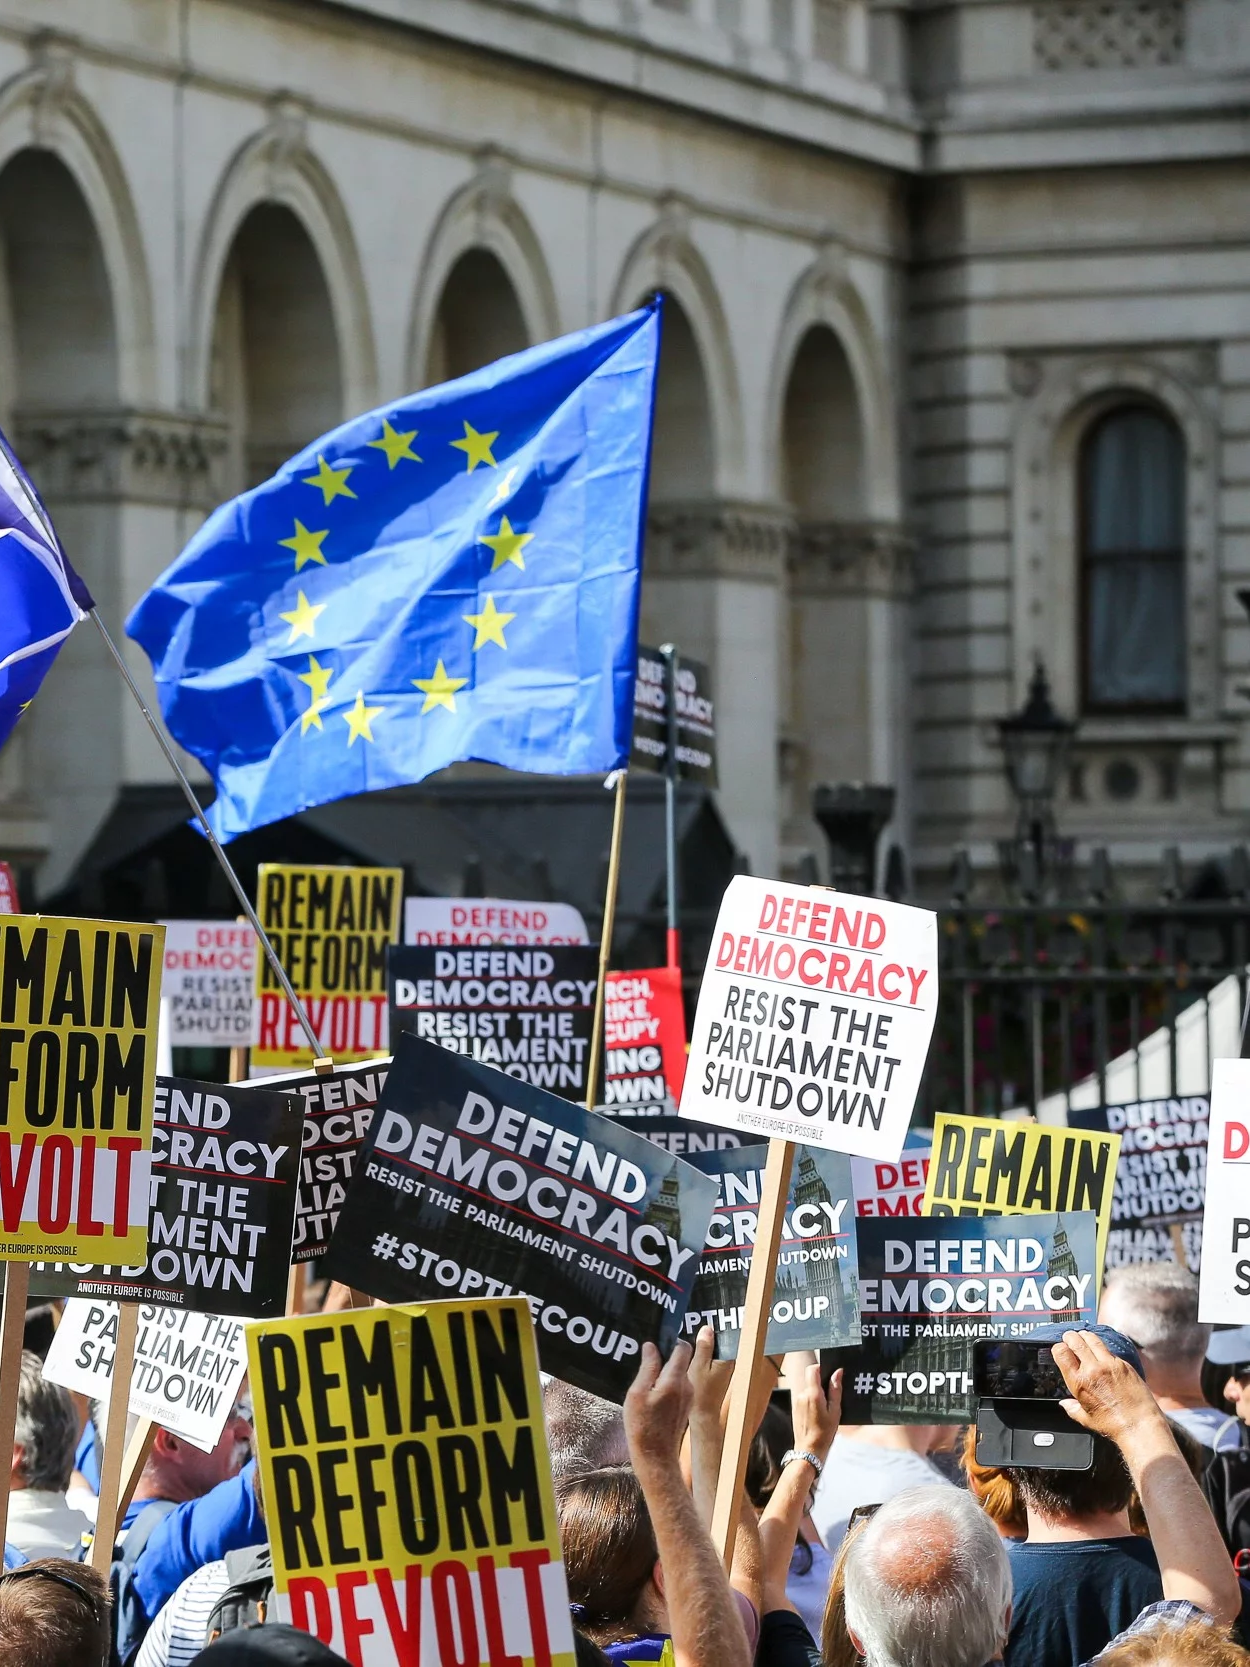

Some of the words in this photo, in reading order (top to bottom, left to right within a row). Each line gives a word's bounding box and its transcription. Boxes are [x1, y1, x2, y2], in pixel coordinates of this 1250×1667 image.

[264, 873, 396, 932] REMAIN
[451, 906, 548, 931] DEFEND
[757, 893, 887, 951] DEFEND
[165, 951, 253, 970] DEMOC
[260, 932, 391, 993] REFORM
[434, 950, 555, 978] DEFEND
[715, 931, 929, 1006] DEMOCRACY
[395, 978, 598, 1007] DEMOCRACY
[605, 976, 655, 1001] RCH,
[258, 992, 390, 1055] REVOLT
[417, 1012, 510, 1038] RESIST
[517, 1012, 574, 1037] THE
[605, 1018, 660, 1044] CUPY
[723, 985, 820, 1036] RESIST
[830, 1004, 894, 1051] THE
[705, 1021, 902, 1093] PARLIAMENT
[701, 1060, 887, 1132] SHUTDOWN
[1106, 1096, 1210, 1130] DEFEND
[456, 1091, 647, 1204] DEFEND
[736, 1112, 762, 1129] ANOTHER
[761, 1117, 786, 1133] EUROPE
[786, 1122, 793, 1135] IS
[794, 1124, 824, 1141] POSSIBLE
[151, 1131, 290, 1180] CRACY
[933, 1123, 1111, 1217] REMAIN
[176, 1181, 251, 1221] THE
[374, 1109, 695, 1282] DEMOCRACY
[7, 1243, 35, 1255] EUROPE
[36, 1244, 44, 1255] IS
[44, 1244, 78, 1257] POSSIBLE
[365, 1162, 426, 1198] RESIST
[428, 1187, 461, 1215] THE
[464, 1204, 577, 1263] PARLIAMENT
[578, 1254, 677, 1314] SHUTDOWN
[884, 1238, 1044, 1274] DEFEND
[77, 1282, 113, 1295] ANOTHER
[113, 1285, 143, 1297] EUROPE
[144, 1288, 152, 1298] IS
[152, 1289, 185, 1303] POSSIBLE
[859, 1273, 1092, 1313] EMOCRACY
[81, 1306, 240, 1386] PALIAMENT
[201, 1313, 243, 1353] THE
[883, 1324, 910, 1338] THE
[914, 1323, 1005, 1338] PARLIAMENT
[75, 1341, 224, 1418] SHTDOWN
[257, 1307, 531, 1450] REMAIN
[853, 1370, 974, 1396] #STOPTH
[272, 1425, 546, 1571] REFORM
[287, 1547, 556, 1667] REVOLT
